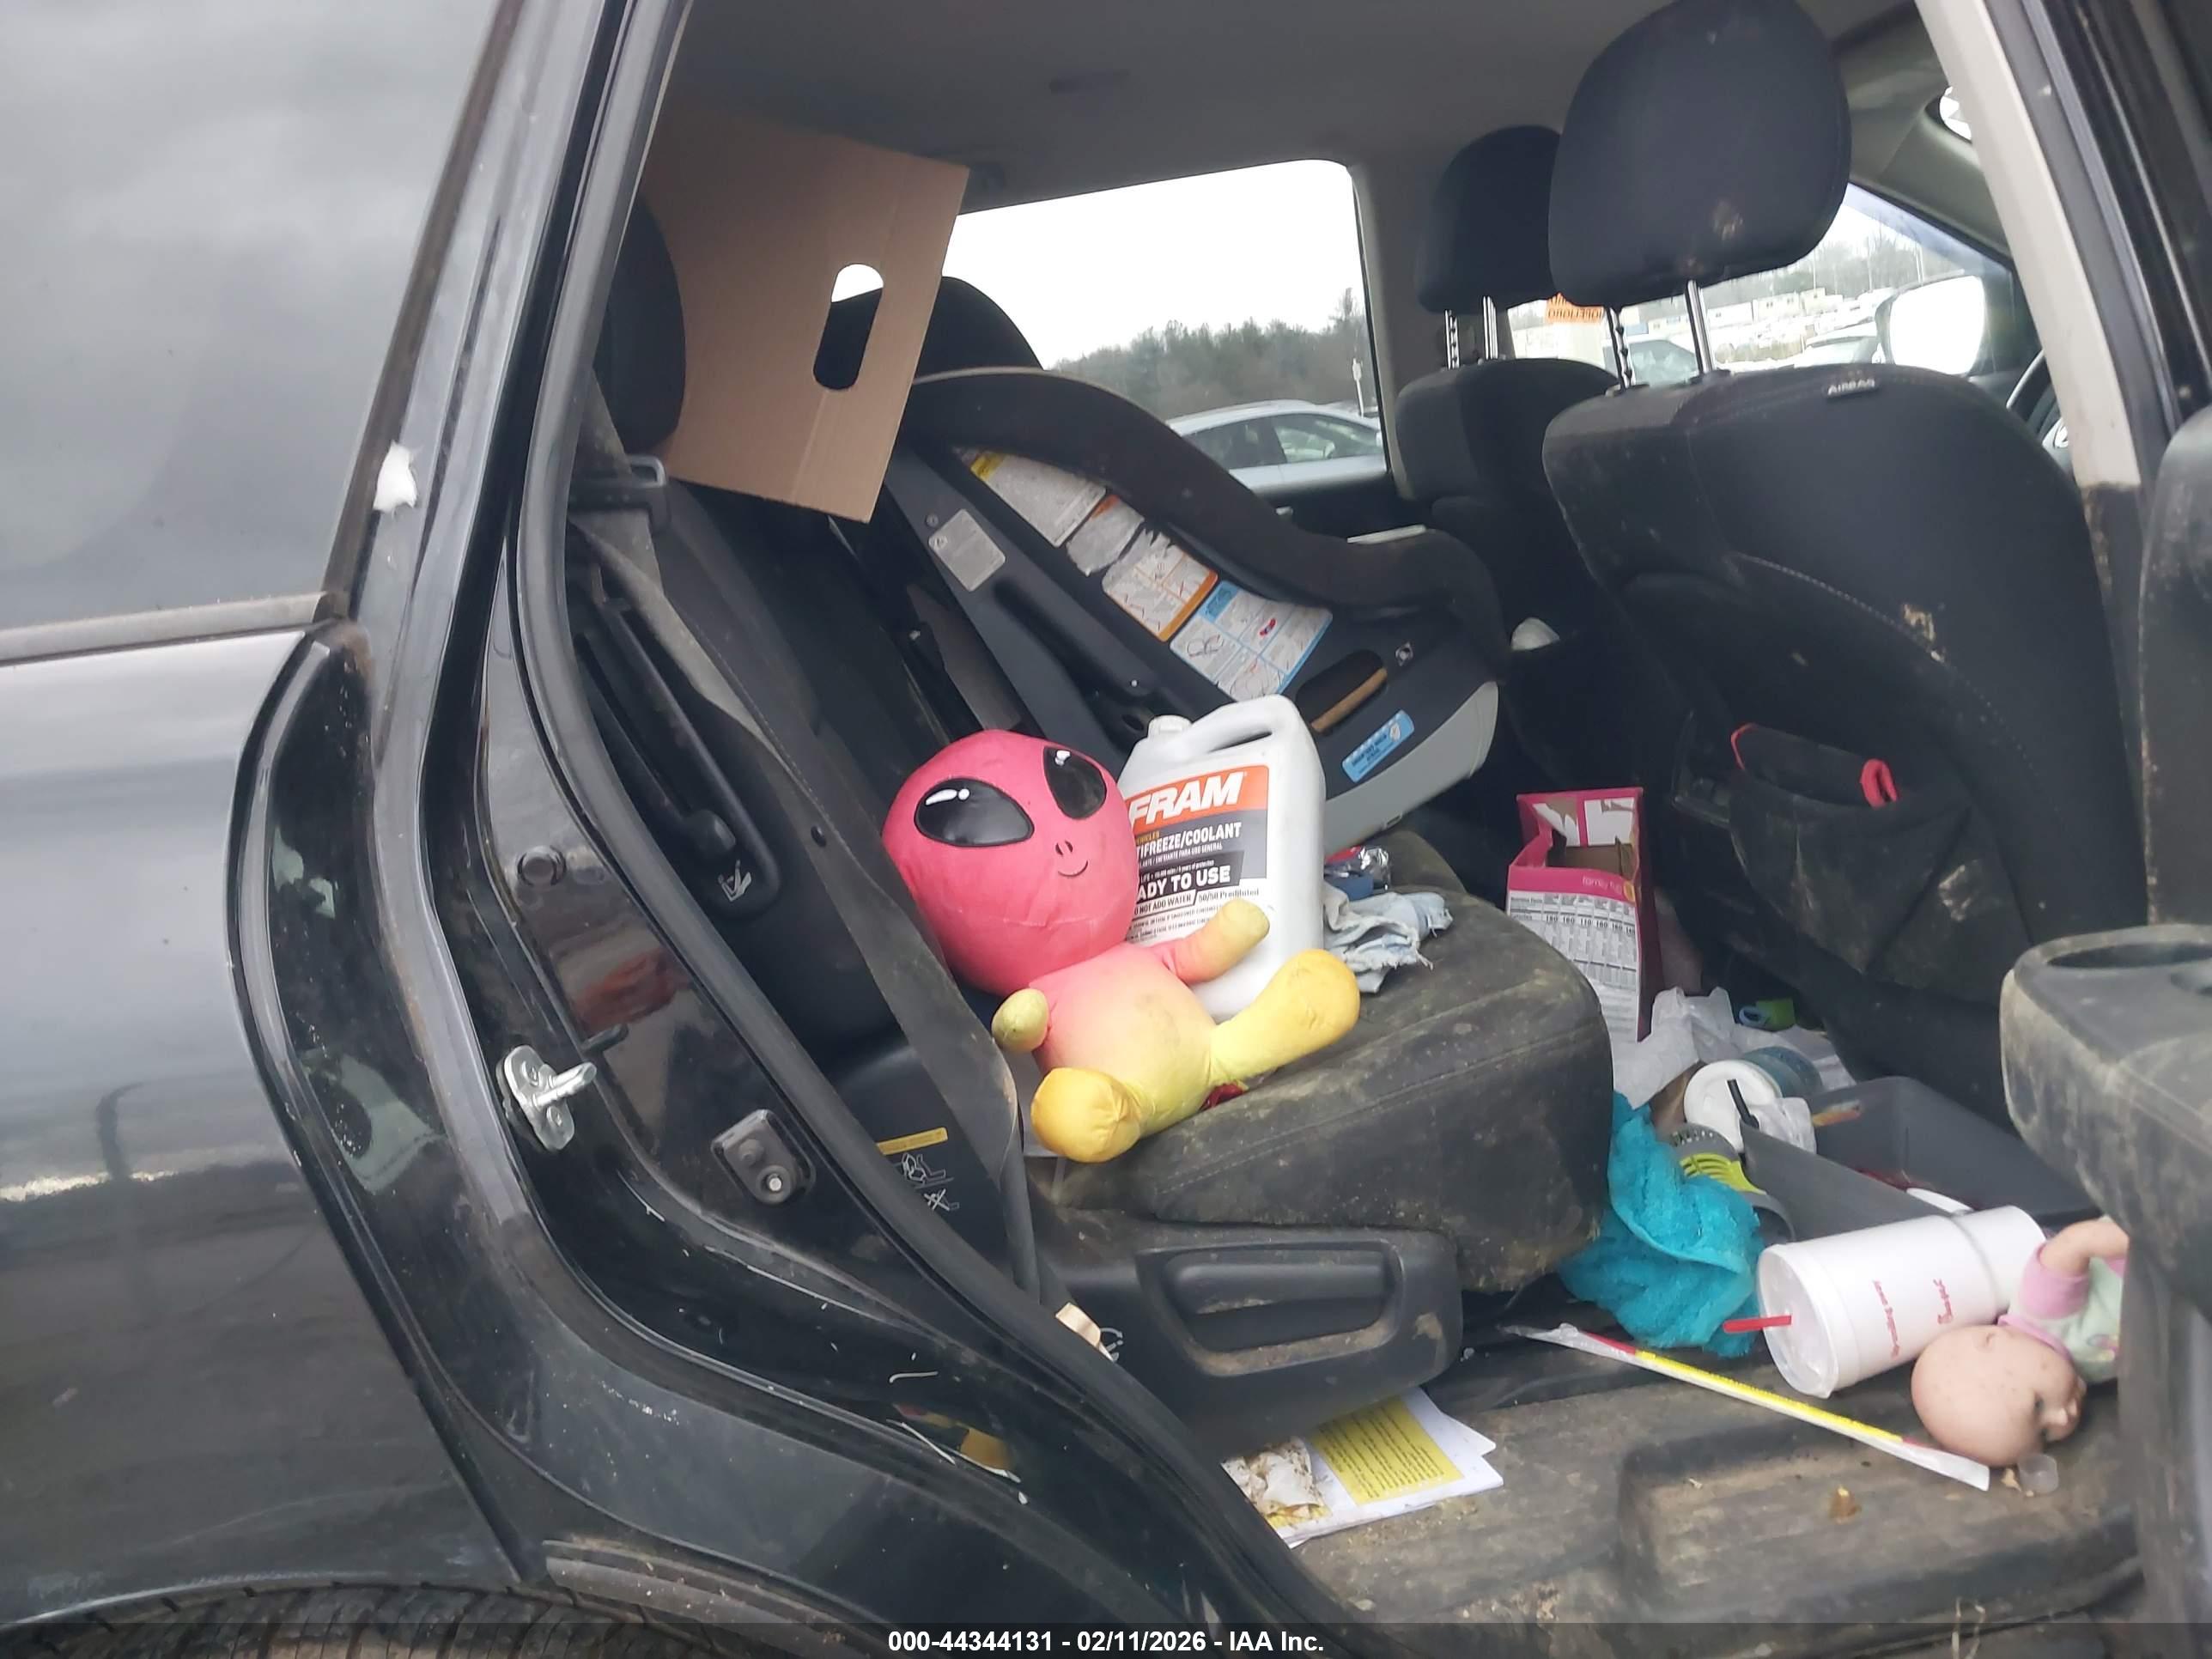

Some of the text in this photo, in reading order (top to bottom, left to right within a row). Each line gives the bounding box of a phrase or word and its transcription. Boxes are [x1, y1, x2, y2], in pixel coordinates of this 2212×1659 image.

[1128, 771, 1244, 828] FRAM
[1136, 821, 1243, 859] TIFREEZE/COOLANT
[1136, 865, 1231, 902] ADY TO USE
[1139, 904, 1152, 915] NOT
[1152, 899, 1166, 911] ADD
[1168, 894, 1192, 907] WATER
